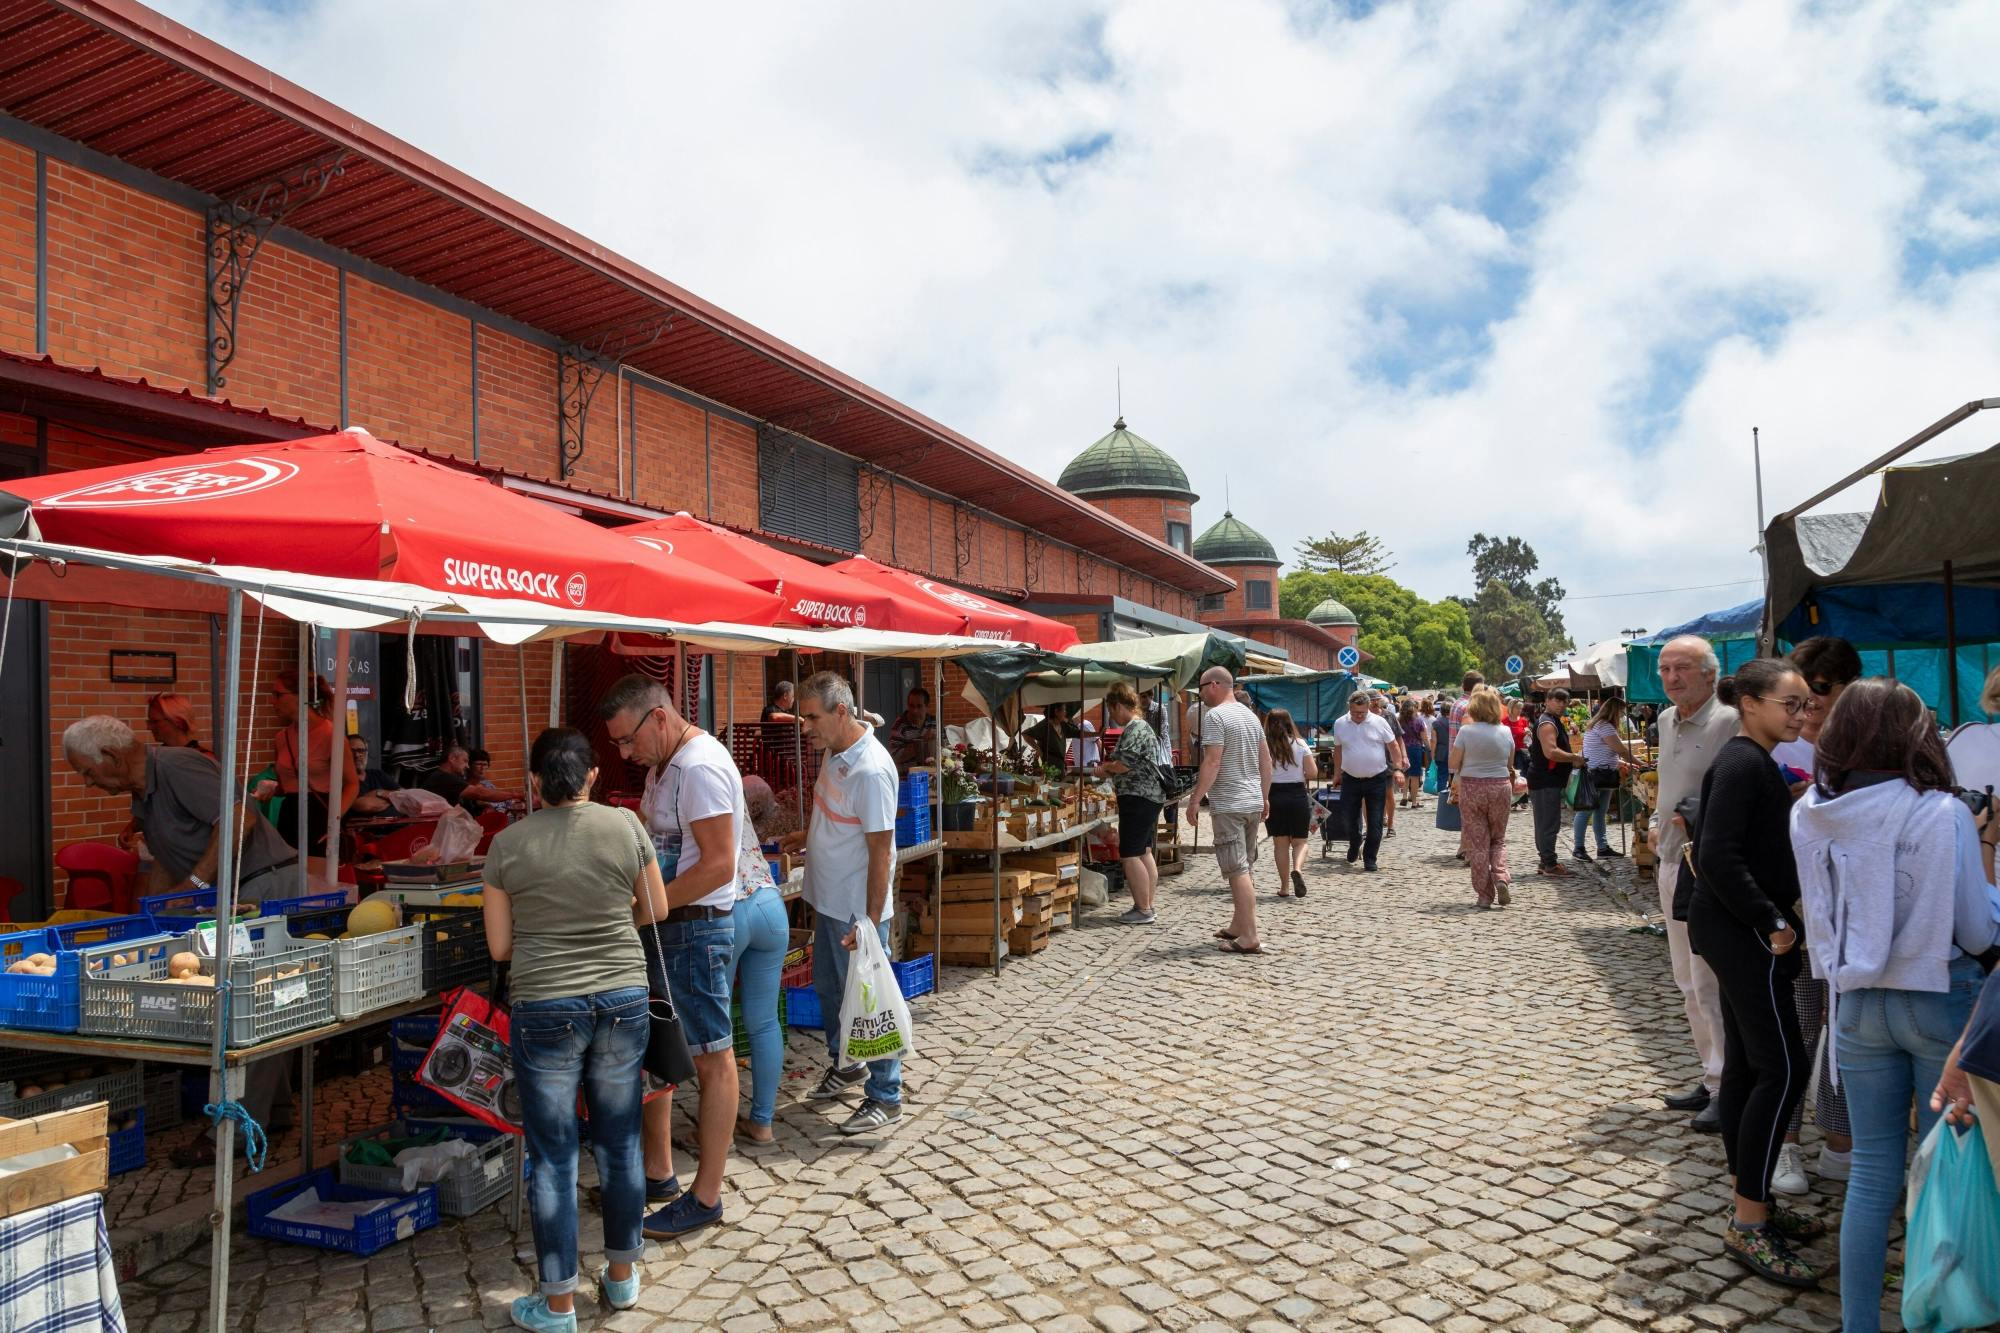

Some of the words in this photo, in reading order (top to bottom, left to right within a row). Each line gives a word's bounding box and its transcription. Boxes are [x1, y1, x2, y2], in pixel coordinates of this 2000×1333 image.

[444, 557, 508, 590] SUPER
[507, 568, 560, 599] BOCK
[790, 599, 825, 619] SUPER
[824, 604, 852, 624] BOCK
[140, 996, 177, 1010] MAC
[853, 1010, 894, 1028] RTILZE
[851, 1029, 866, 1039] ET
[869, 1022, 897, 1039] SACO.
[61, 1090, 93, 1108] MAC
